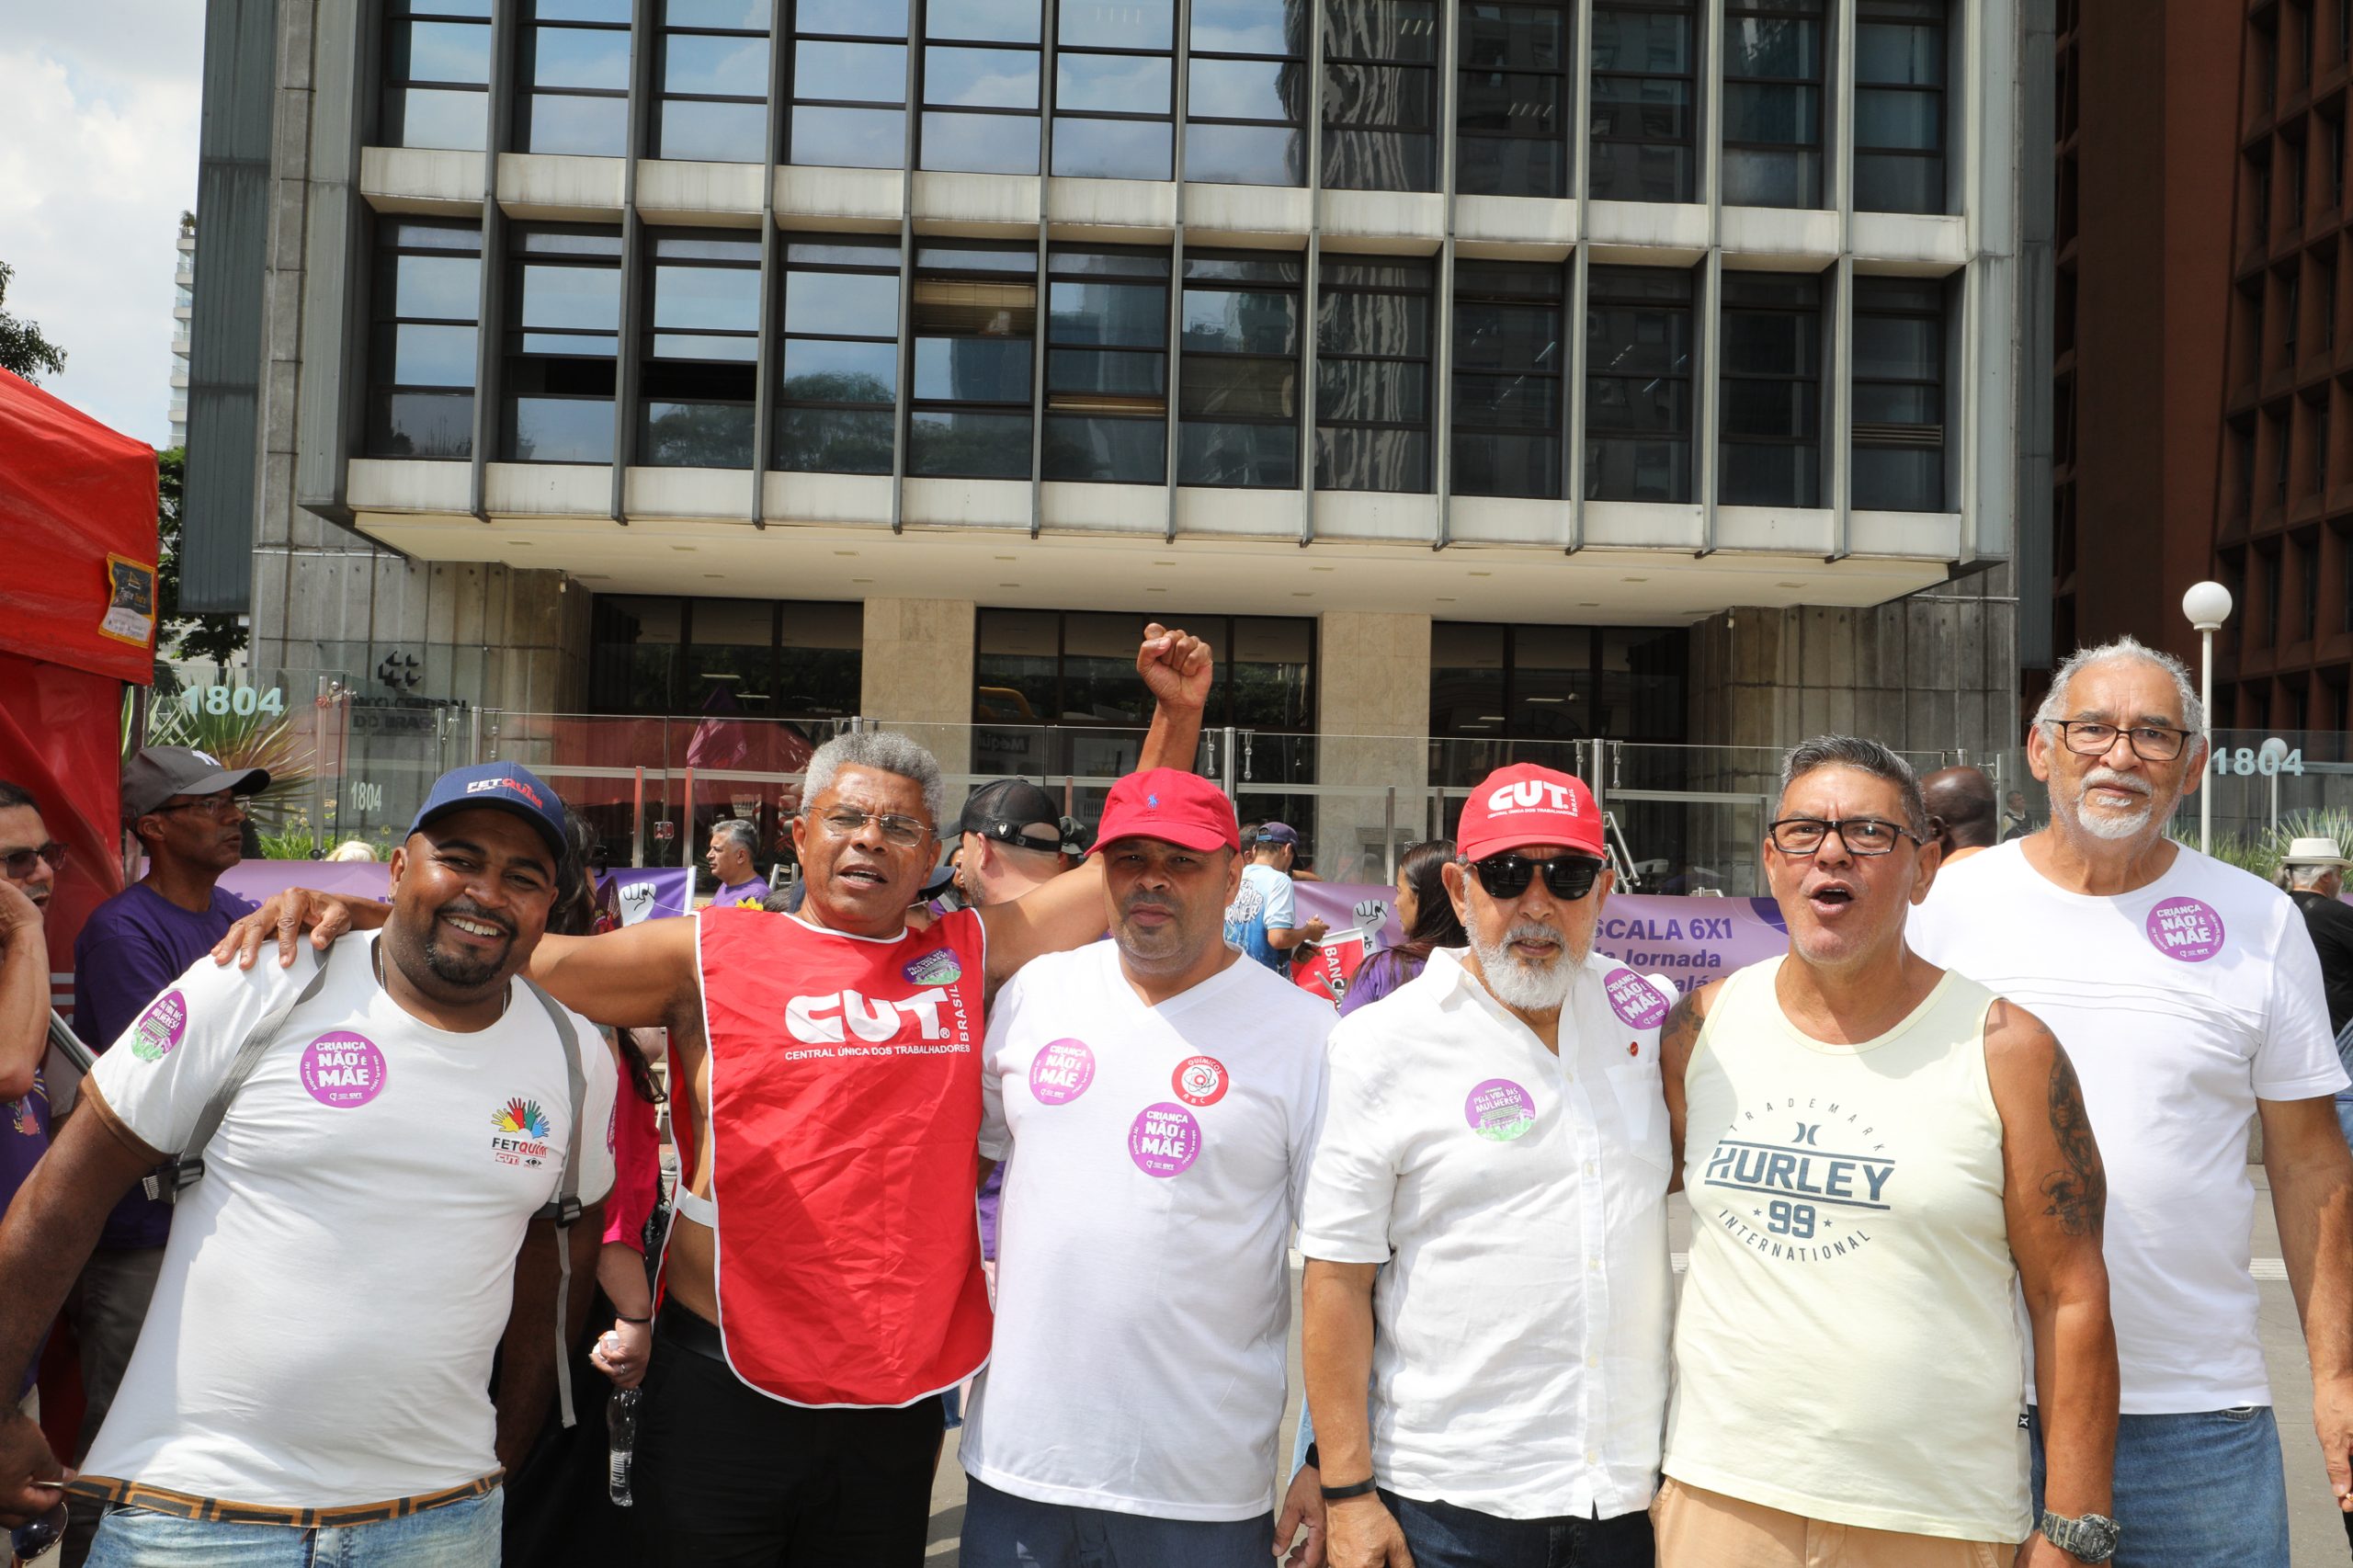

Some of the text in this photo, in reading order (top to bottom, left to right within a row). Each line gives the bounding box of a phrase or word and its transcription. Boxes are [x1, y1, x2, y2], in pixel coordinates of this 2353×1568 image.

[182, 685, 284, 716] 1804
[2211, 747, 2305, 776] 1804
[350, 781, 382, 812] 1804
[2156, 904, 2202, 917] CRIANÇA
[1689, 918, 1733, 939] 6X1
[2161, 915, 2197, 931] NÃO
[2164, 926, 2212, 947] MÃE
[1625, 949, 1722, 968] Jornada
[1614, 983, 1643, 1004] NÃO
[949, 984, 970, 1042] BRASIL
[1622, 993, 1661, 1019] MÃE
[315, 1041, 367, 1051] CRIANÇA
[785, 1044, 971, 1061] CENTRAL ÚNICA DOS TRABALHADORES
[1050, 1045, 1086, 1057] CRIANÇA
[317, 1051, 358, 1067] NÃO
[1045, 1053, 1076, 1069] NÃO
[317, 1066, 369, 1087] MÃE
[1039, 1067, 1079, 1088] MÃE
[1473, 1095, 1489, 1105] PELA
[1490, 1091, 1506, 1100] VIDA
[1506, 1087, 1518, 1096] DAS
[1475, 1094, 1522, 1113] MULHERES!
[1145, 1111, 1188, 1123] CRIANÇA
[1729, 1098, 1885, 1152] TRADEMARK
[1145, 1120, 1180, 1138] NÃO
[1141, 1136, 1186, 1158] MÃE
[1706, 1147, 1895, 1201] HURLEY
[1768, 1199, 1815, 1239] 99
[1719, 1210, 1871, 1262] INTERNATIONAL
